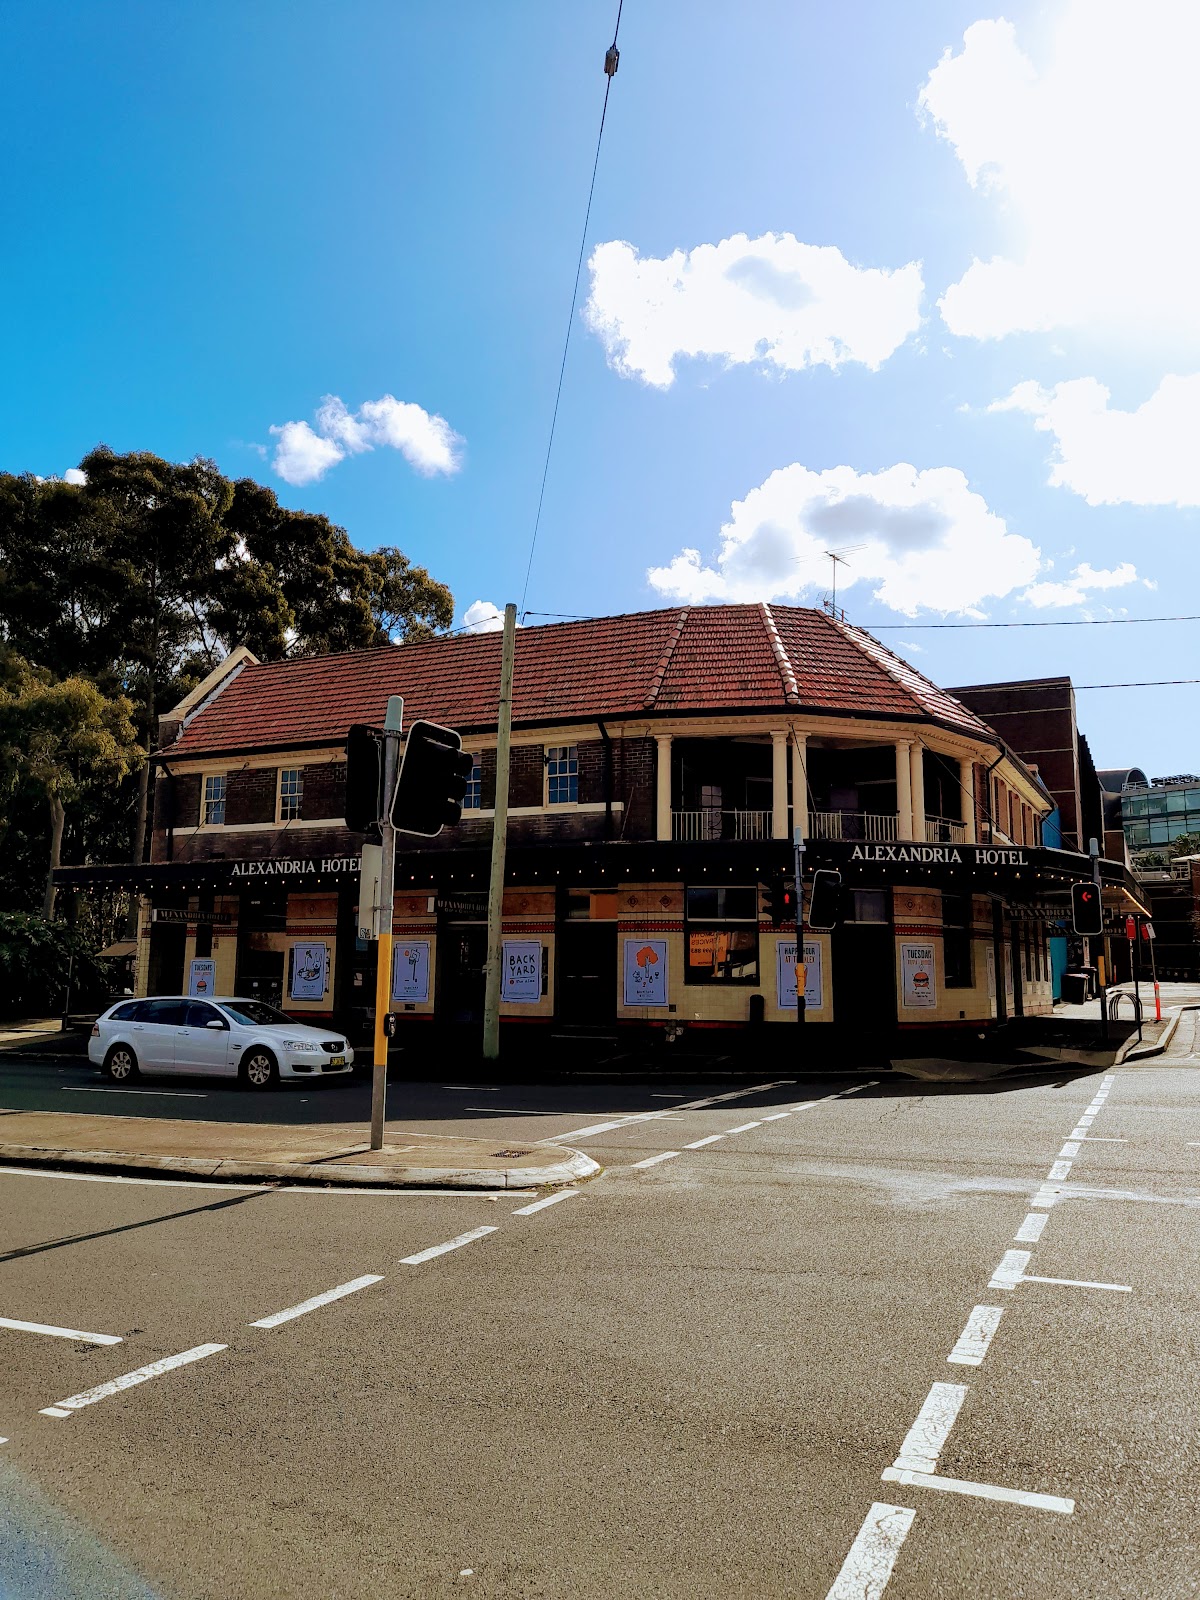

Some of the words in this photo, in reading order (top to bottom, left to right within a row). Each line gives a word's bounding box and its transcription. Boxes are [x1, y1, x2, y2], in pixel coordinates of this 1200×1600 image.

[851, 844, 963, 863] ALEXANDRIA
[975, 849, 1029, 866] HOTEL
[231, 860, 316, 876] ALEXANDRIA
[785, 947, 797, 955] HAPP
[510, 954, 536, 965] BACK
[510, 965, 536, 976] YARD
